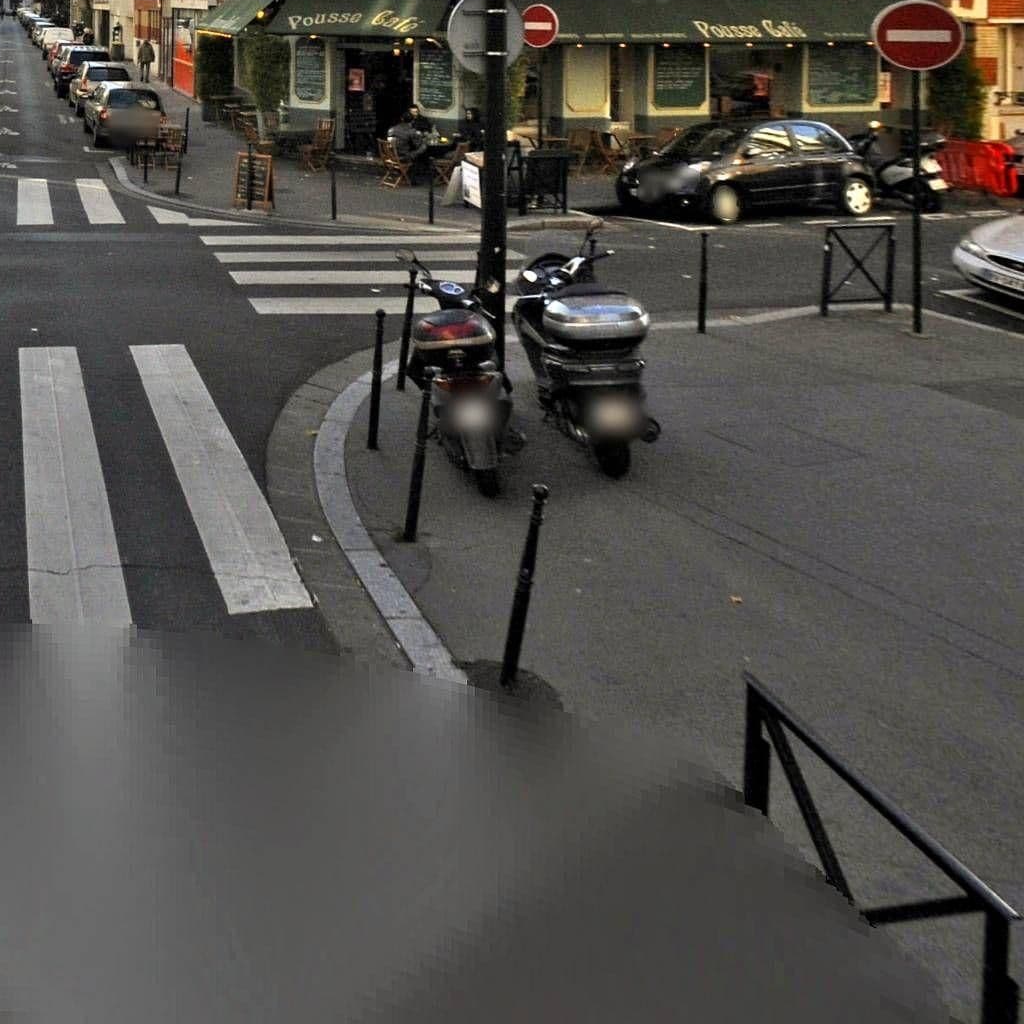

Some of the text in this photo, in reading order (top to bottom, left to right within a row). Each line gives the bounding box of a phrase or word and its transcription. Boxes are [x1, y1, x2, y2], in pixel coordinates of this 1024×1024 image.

[288, 9, 425, 33] Pousse Café
[692, 19, 808, 38] Pousse Café
